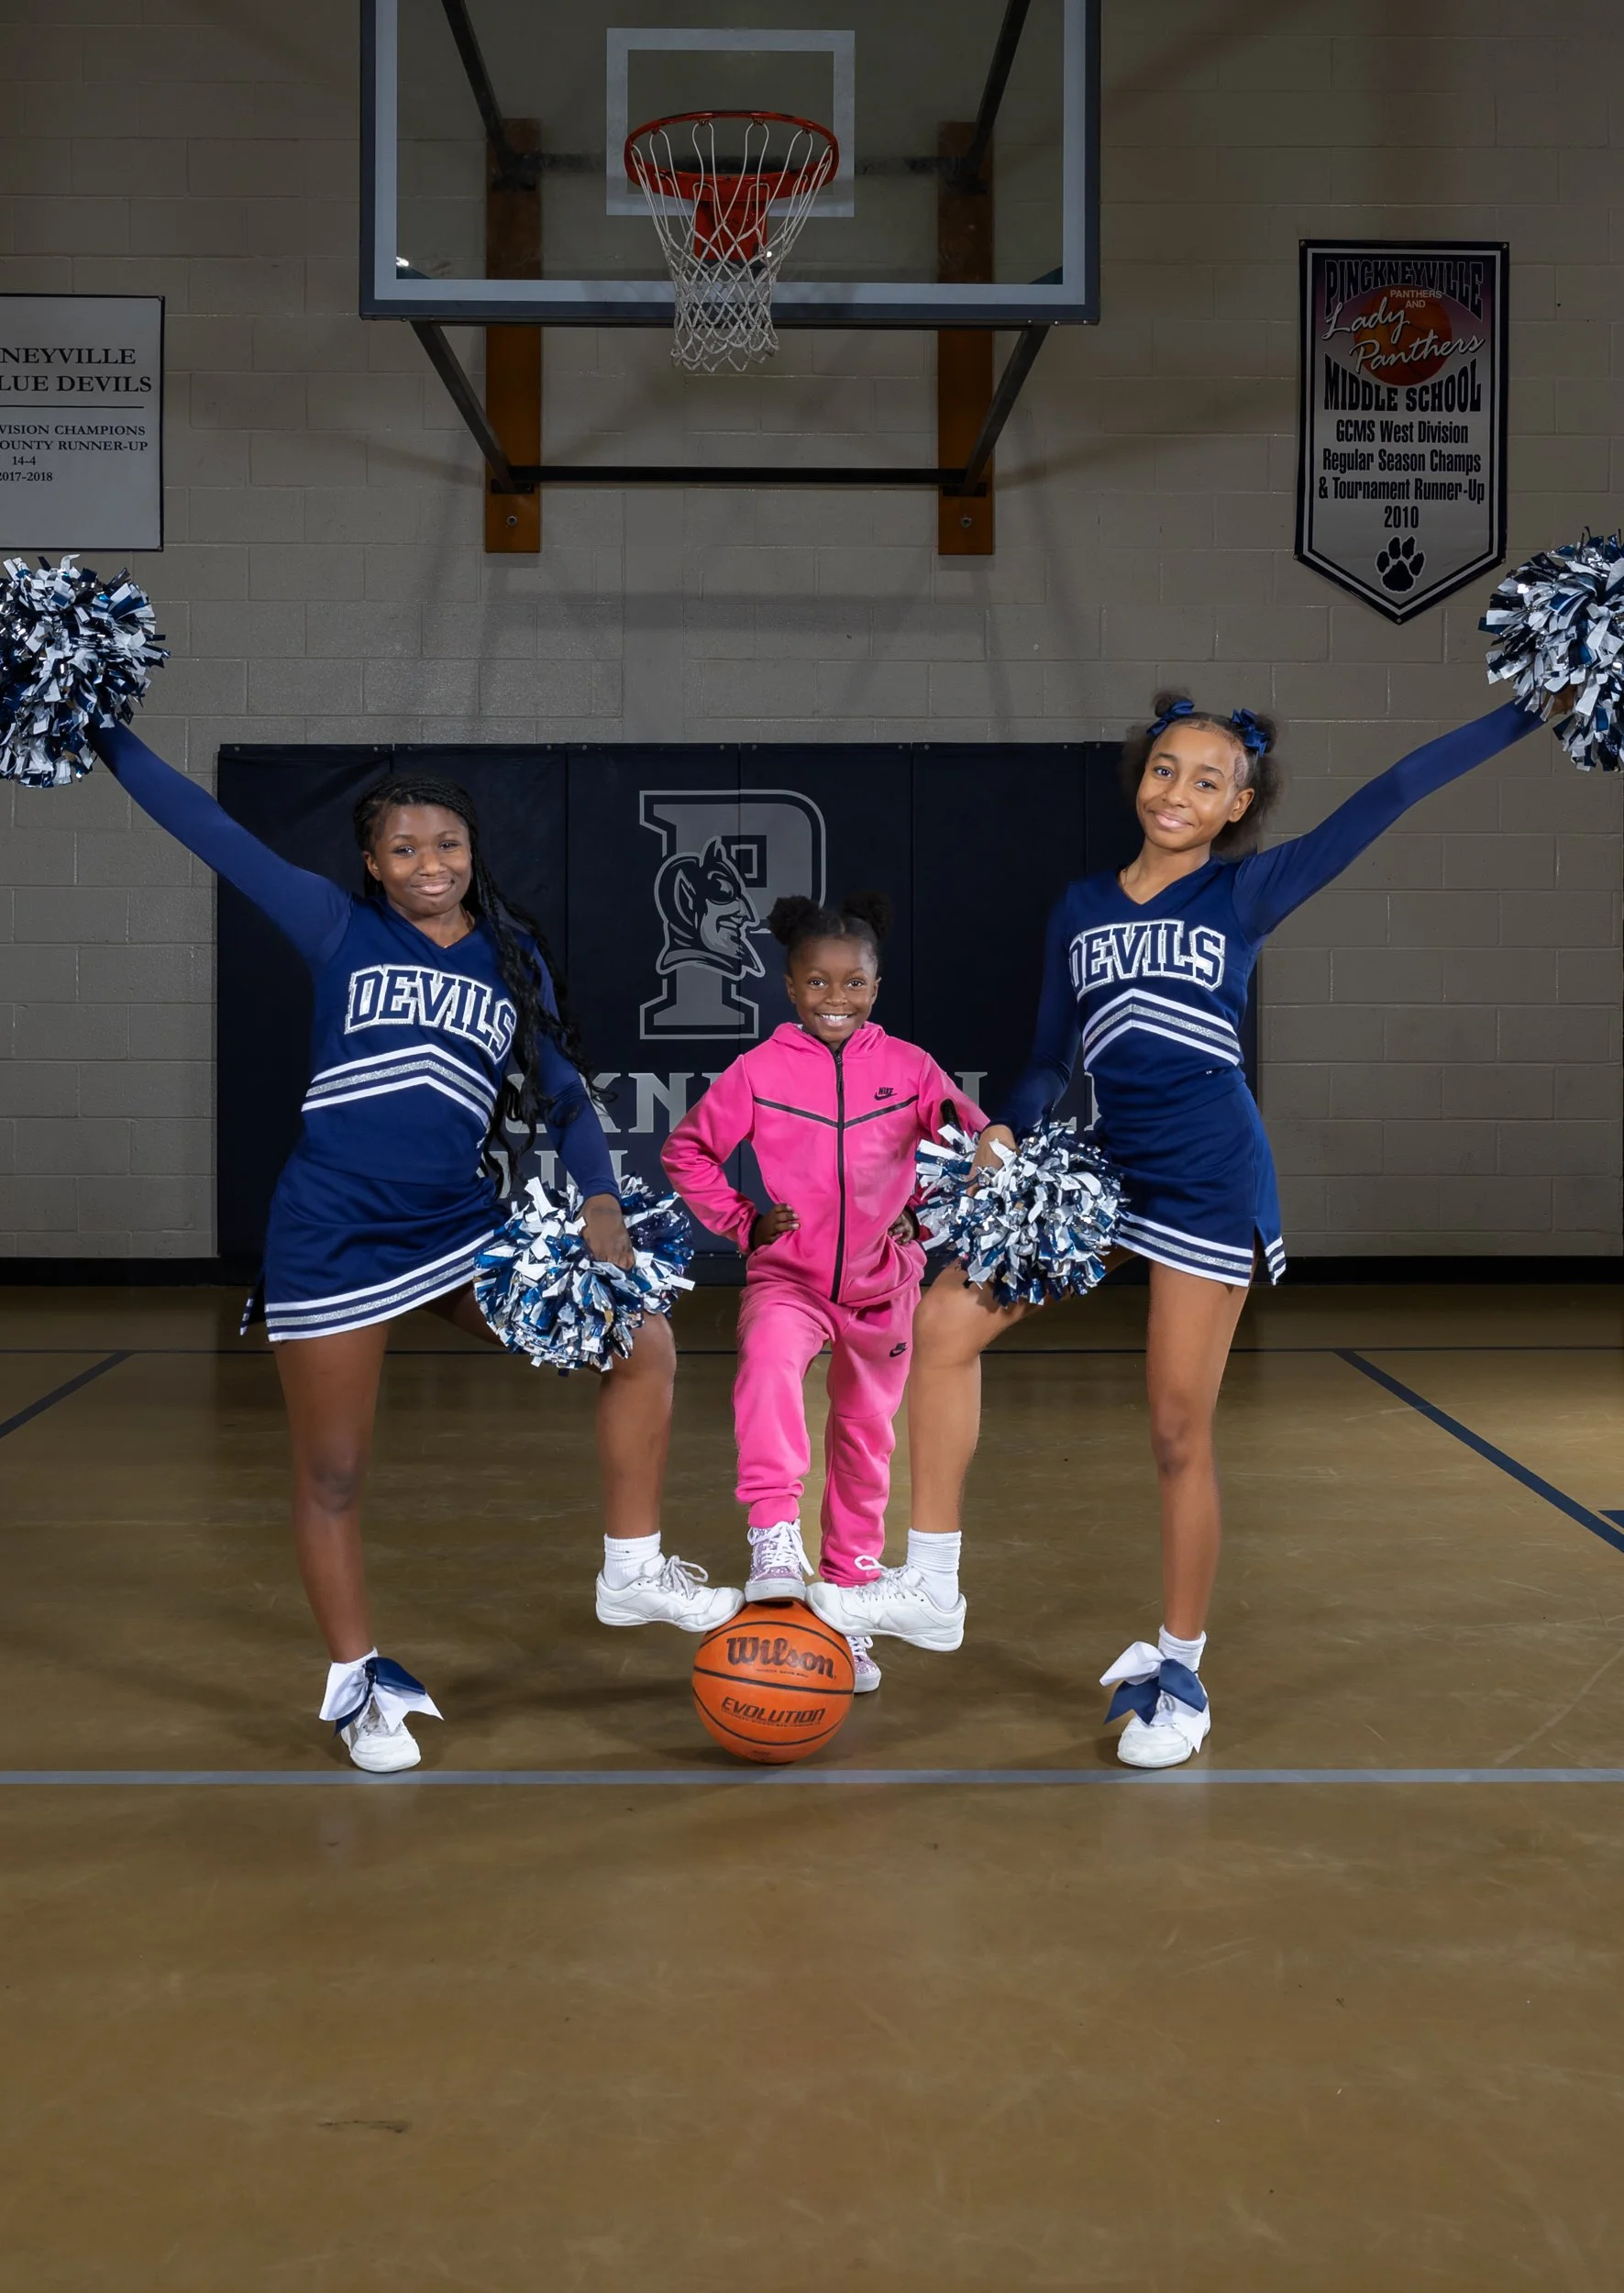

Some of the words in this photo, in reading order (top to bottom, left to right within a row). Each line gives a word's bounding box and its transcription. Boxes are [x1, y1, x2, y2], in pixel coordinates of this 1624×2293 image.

[1324, 260, 1484, 322] PINCKNEYVILLE
[1390, 289, 1442, 299] PANTHERS
[1405, 299, 1426, 308] AND
[1321, 296, 1410, 343] Lady
[1349, 329, 1486, 373] Panthers
[56, 375, 152, 393] DEVILS
[1324, 353, 1398, 412] MIDDLE
[1405, 357, 1482, 413] SCHOOL
[54, 425, 146, 437] CHAMPIONS
[1336, 419, 1375, 443] GCMS
[1380, 420, 1414, 443] West
[1418, 421, 1469, 444] Division
[58, 440, 148, 452] RUNNER-UP
[12, 456, 37, 466] 14-4
[1322, 448, 1375, 474] Regular
[1378, 449, 1425, 471] Season
[1430, 449, 1481, 476] Champs
[1319, 476, 1329, 500] &
[1332, 477, 1410, 500] Tournament
[1414, 478, 1486, 504] Runner-Up
[1384, 505, 1420, 529] 2010
[1069, 919, 1226, 1002] DEVILS
[344, 964, 518, 1065] DEVILS
[726, 1636, 834, 1679] Wilson
[722, 1696, 826, 1724] EVOLUTION
